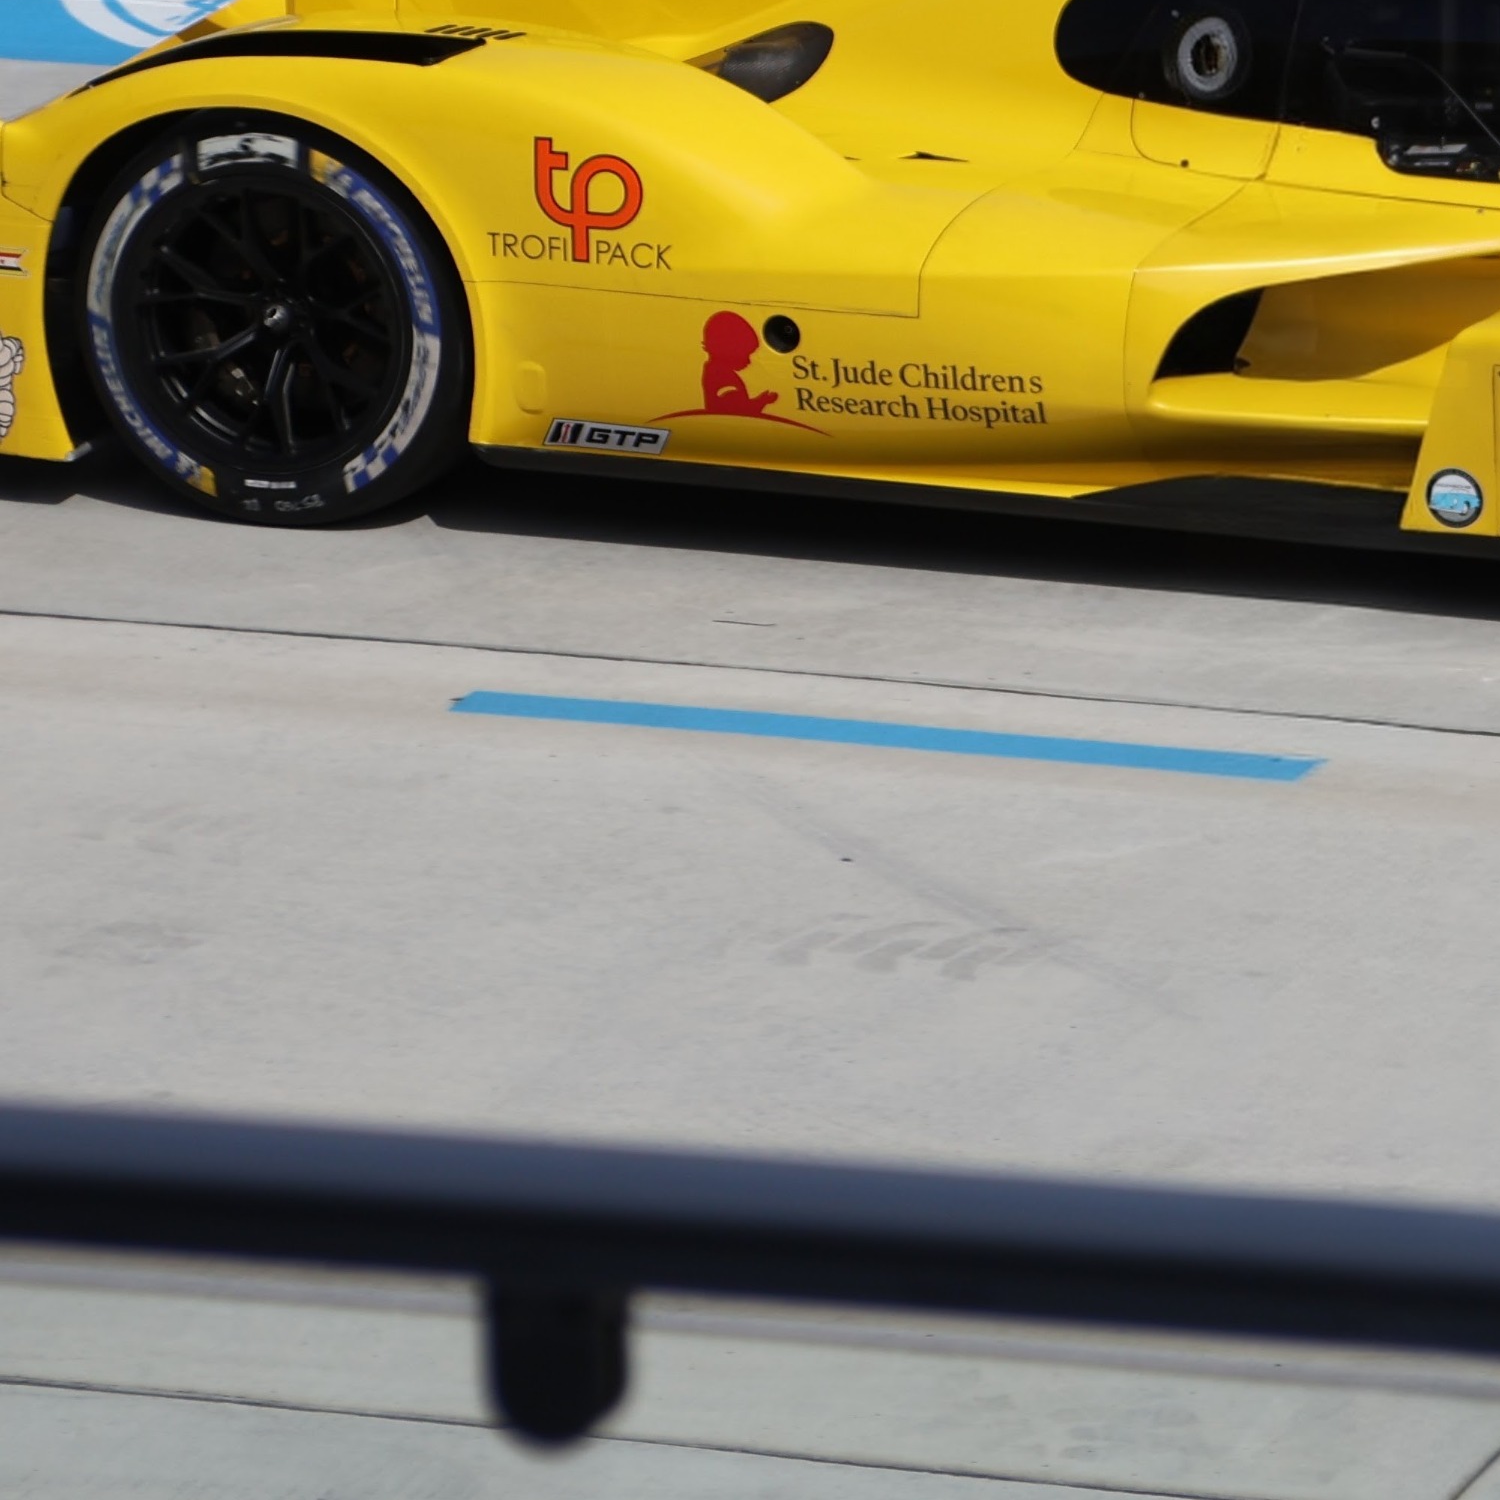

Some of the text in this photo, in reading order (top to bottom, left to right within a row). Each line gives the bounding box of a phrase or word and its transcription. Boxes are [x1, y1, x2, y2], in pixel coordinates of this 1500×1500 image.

[487, 232, 672, 270] TROFI PACK
[792, 355, 828, 382] St.
[831, 358, 893, 388] Jude
[794, 387, 1049, 430] Research Hospital
[585, 427, 660, 448] GTP
